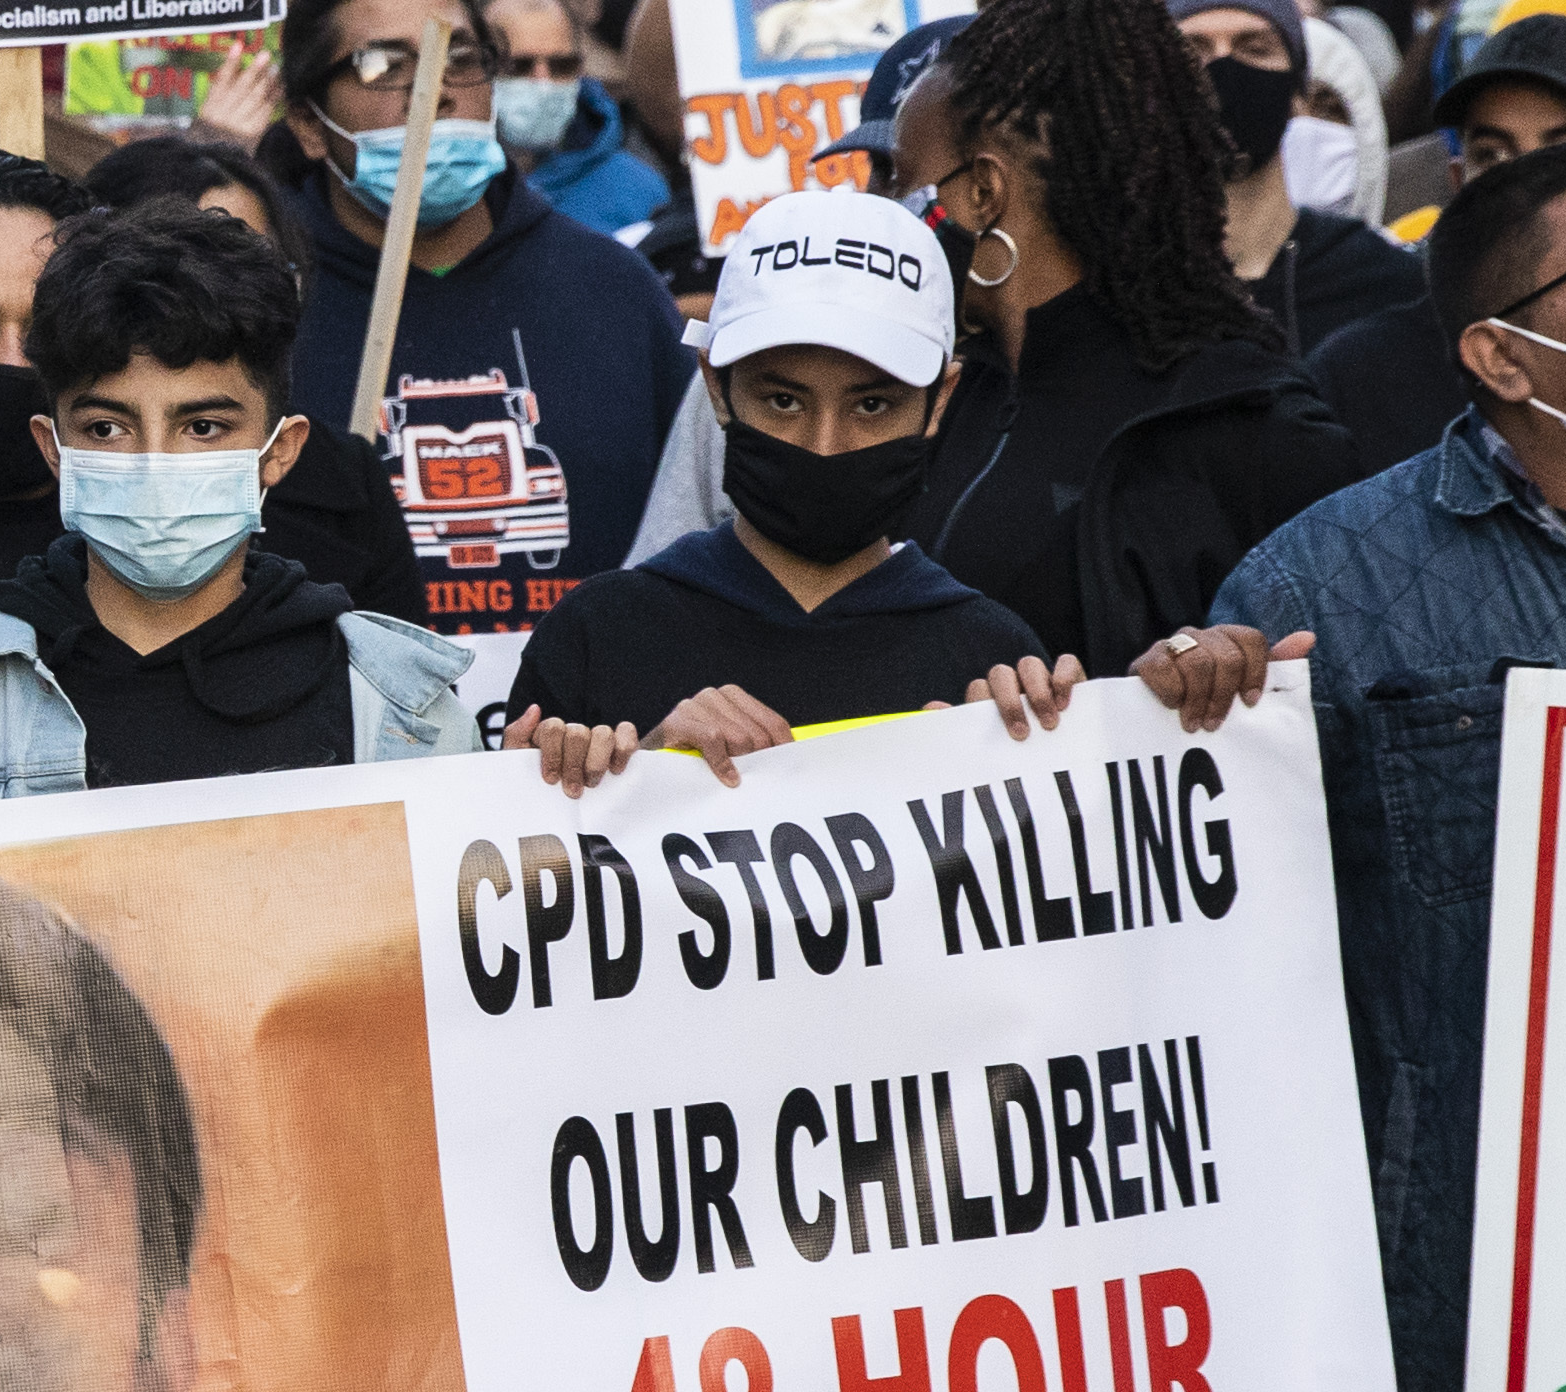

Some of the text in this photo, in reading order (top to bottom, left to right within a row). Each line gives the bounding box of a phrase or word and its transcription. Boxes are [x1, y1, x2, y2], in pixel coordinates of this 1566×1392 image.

[85, 0, 127, 23] and
[686, 80, 870, 165] JUST
[751, 237, 921, 292] TOLEDO
[418, 442, 501, 460] MACK
[426, 458, 504, 498] 52
[525, 577, 582, 613] HI
[459, 748, 1237, 1015] CPD STOP KILLING
[551, 1036, 1219, 1291] OUR CHILDREN!
